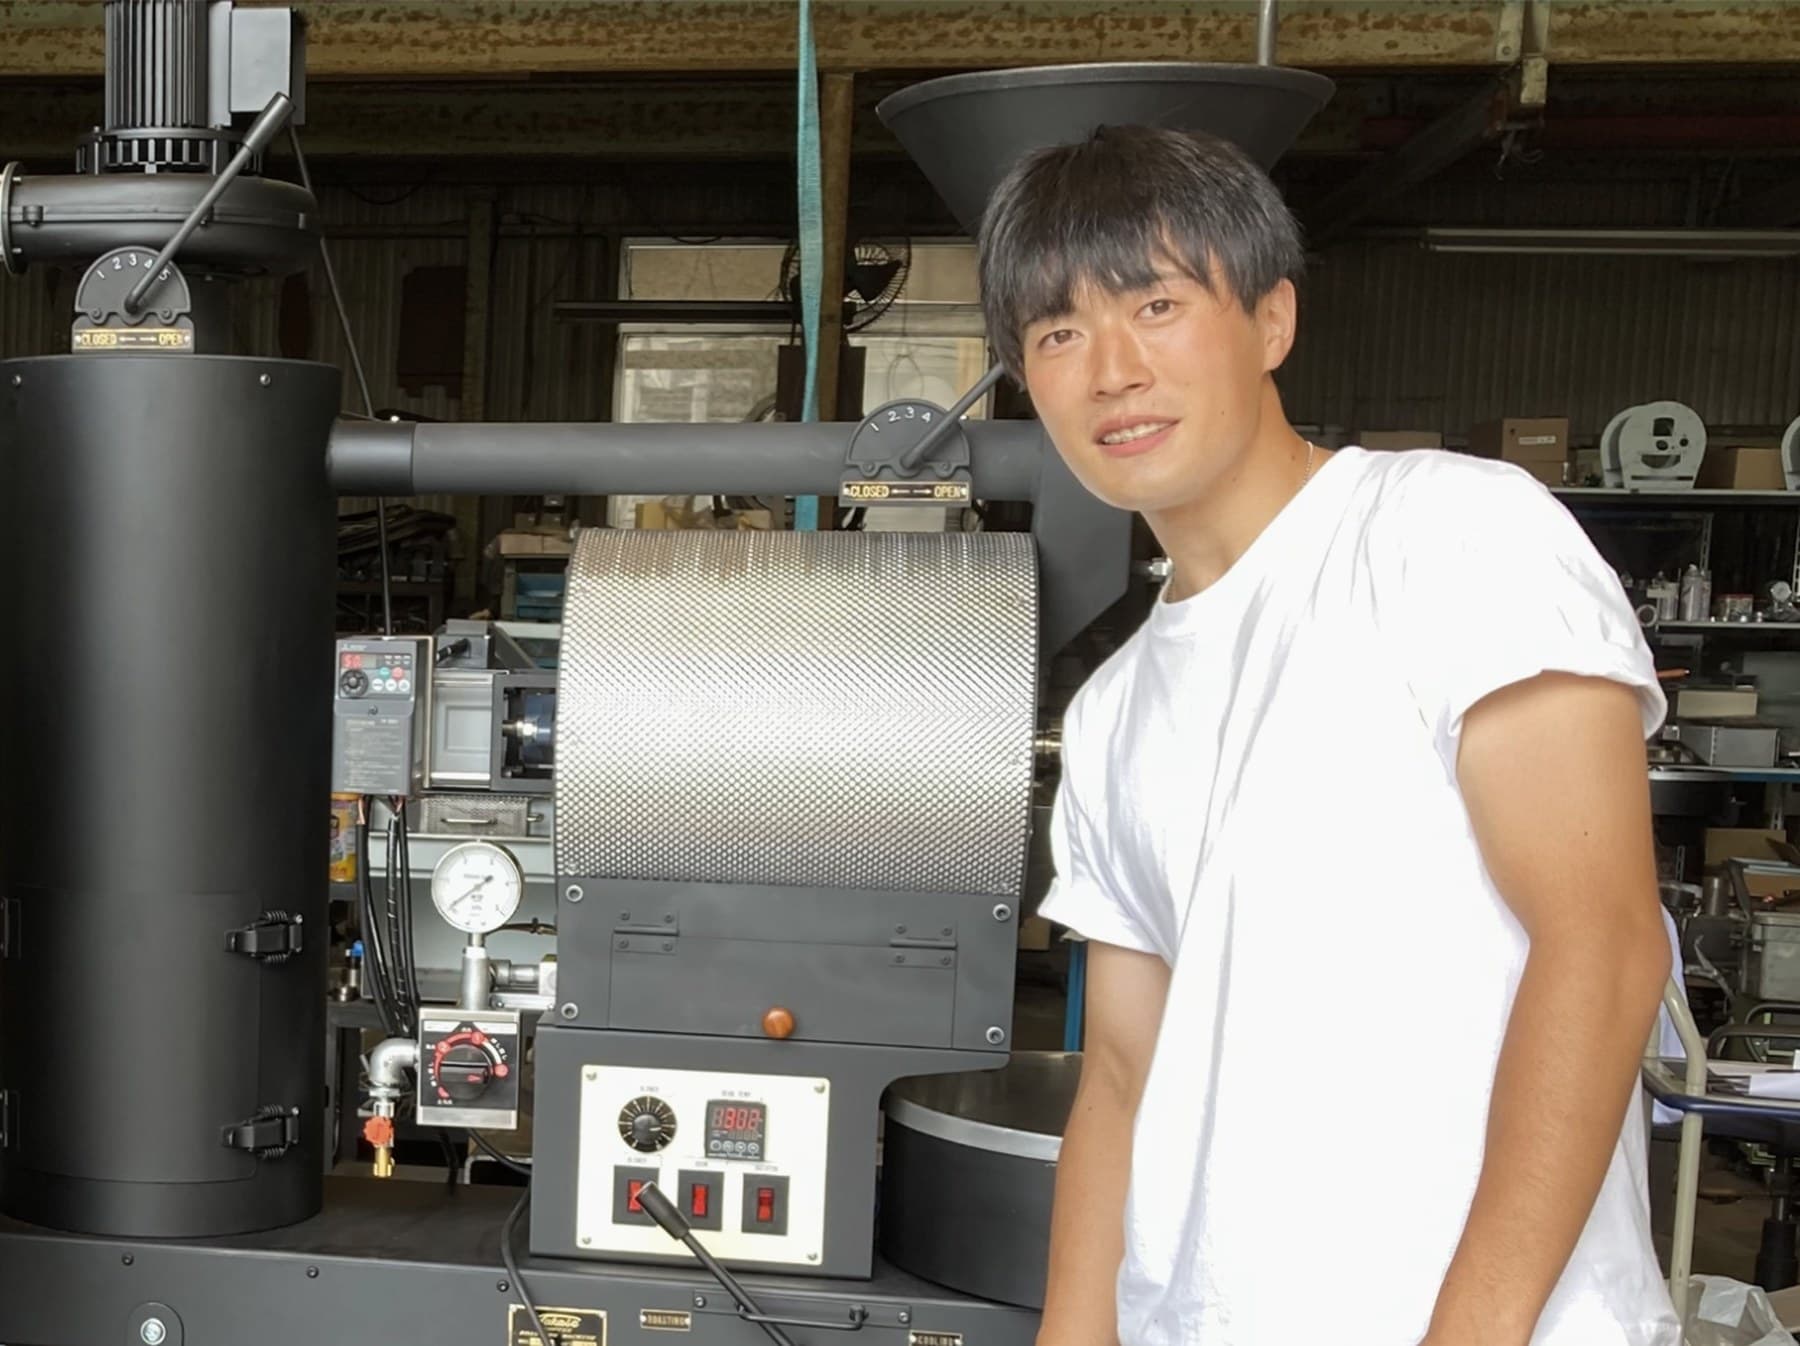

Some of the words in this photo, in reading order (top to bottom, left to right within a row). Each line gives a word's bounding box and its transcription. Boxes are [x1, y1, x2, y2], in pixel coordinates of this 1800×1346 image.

[112, 257, 122, 270] 2
[128, 253, 137, 266] 3
[144, 259, 153, 269] 4
[159, 268, 171, 281] 5
[82, 333, 117, 345] CLOSED
[159, 333, 183, 345] OPEN
[888, 410, 901, 422] 2
[904, 406, 915, 419] 3
[921, 411, 932, 423] 4
[850, 485, 890, 498] CLOSED
[934, 485, 960, 497] OPEN
